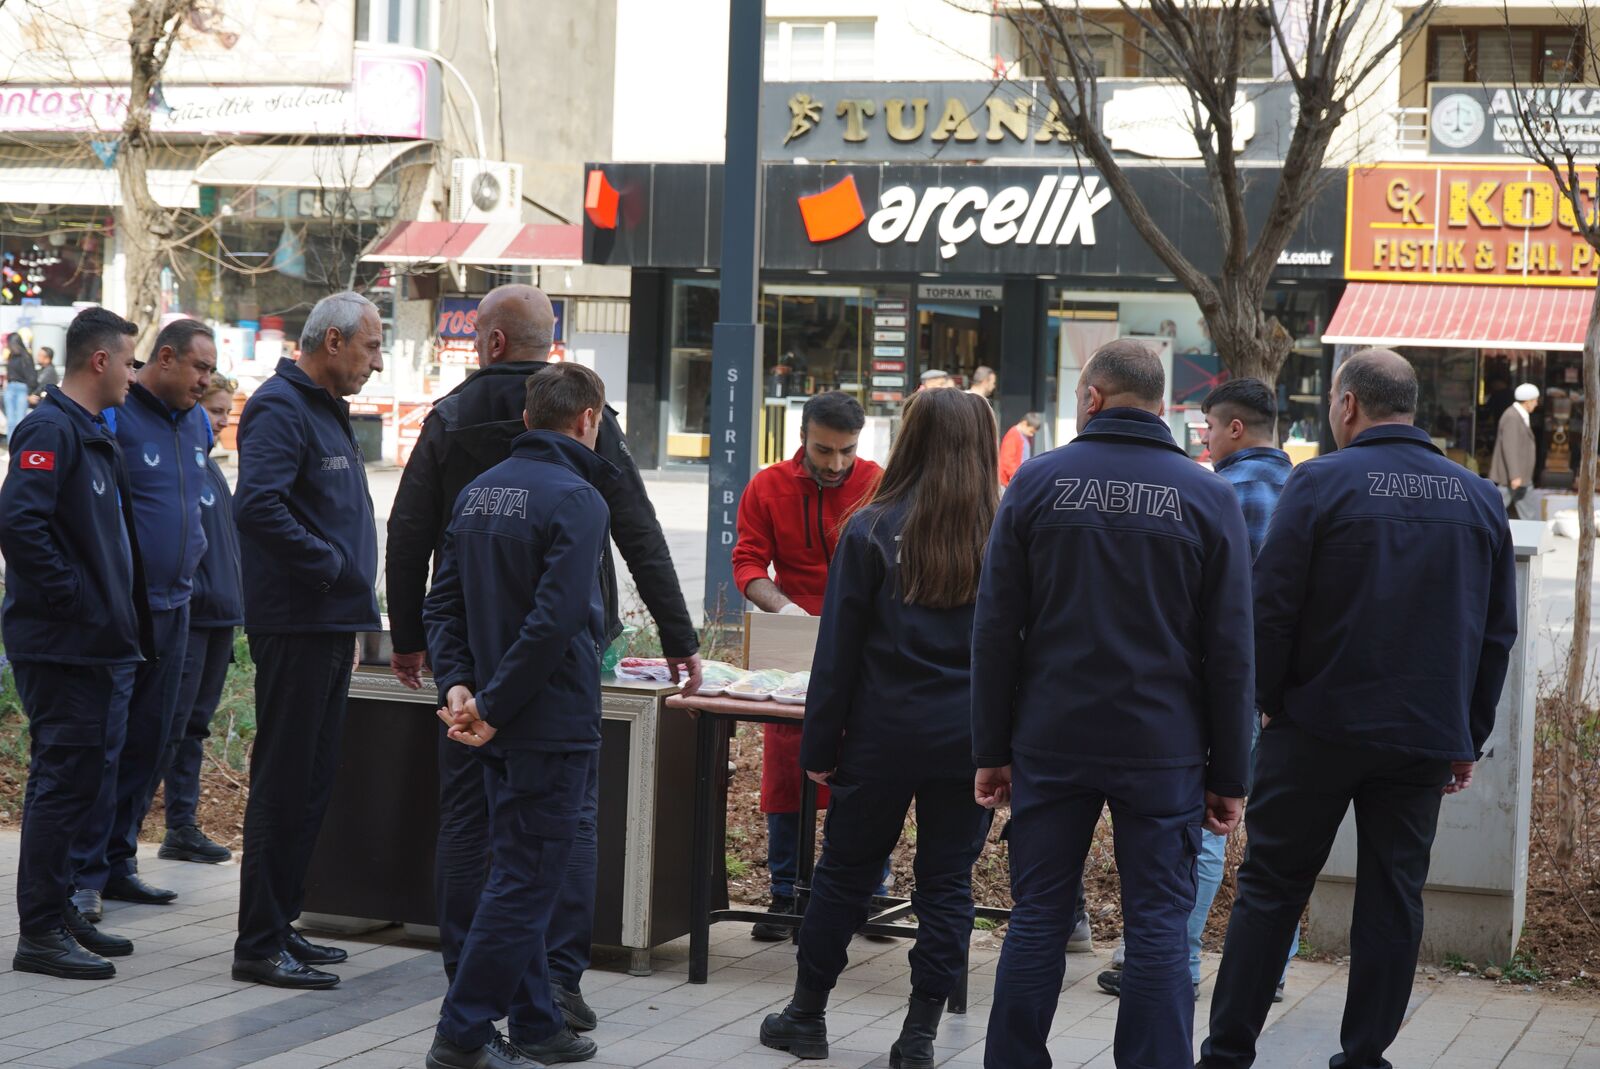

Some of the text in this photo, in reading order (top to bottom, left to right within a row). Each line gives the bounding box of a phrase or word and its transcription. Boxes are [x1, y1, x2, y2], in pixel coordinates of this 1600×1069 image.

[835, 97, 1079, 143] TUANA
[867, 174, 1113, 259] arçelik
[1372, 238, 1465, 269] FISTIK
[1474, 240, 1495, 270] &
[1506, 241, 1563, 272] BAL
[925, 288, 971, 298] TOPRAK
[321, 456, 350, 470] ZABITA
[461, 487, 529, 519] ZABITA
[1053, 478, 1183, 521] ZABITA
[1367, 472, 1468, 501] ZABITA
[721, 490, 734, 545] BLD
